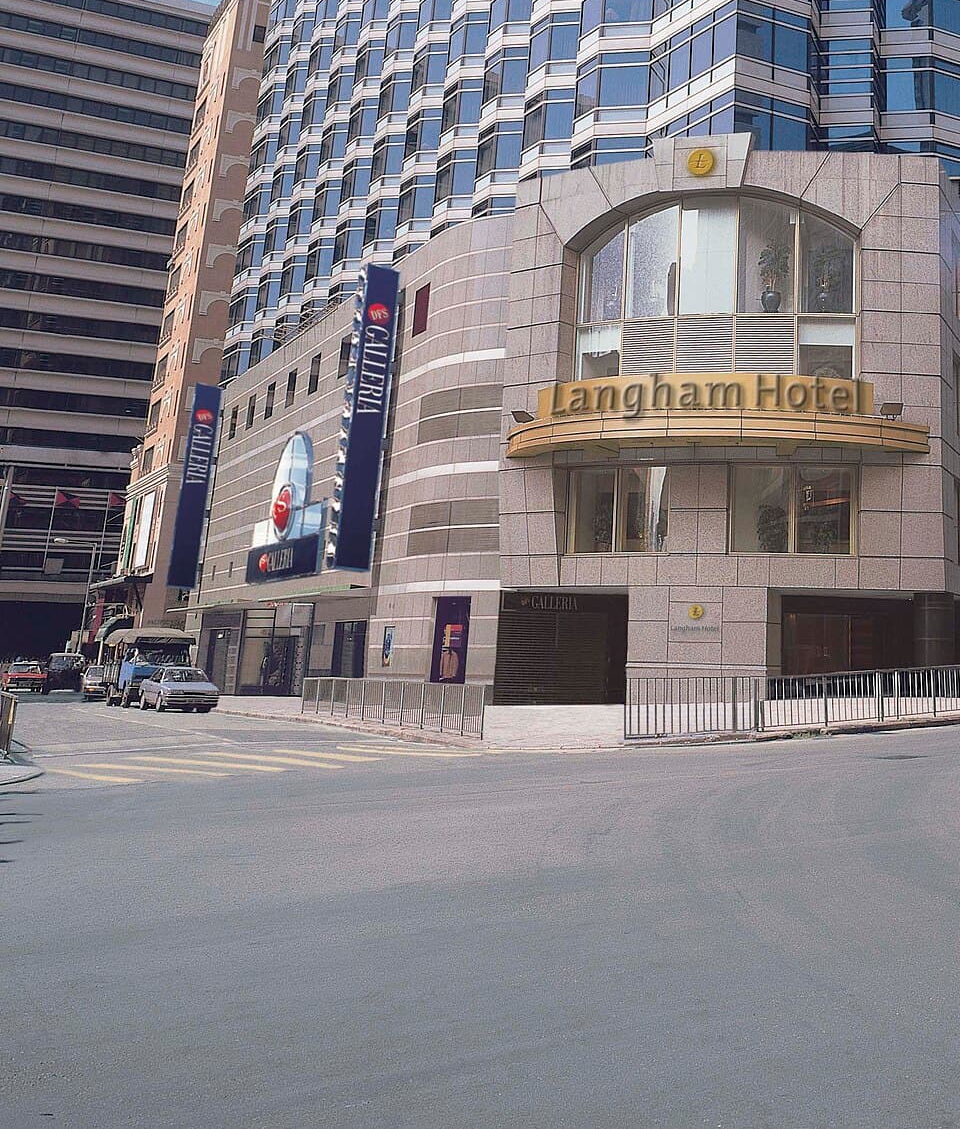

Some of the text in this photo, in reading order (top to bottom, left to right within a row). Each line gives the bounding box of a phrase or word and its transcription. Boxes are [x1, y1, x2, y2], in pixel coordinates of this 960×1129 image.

[356, 325, 390, 415] GALLERIA
[550, 373, 862, 422] Langham Hotel
[185, 423, 213, 484] GALLERIA
[531, 595, 577, 610] GALLERIA
